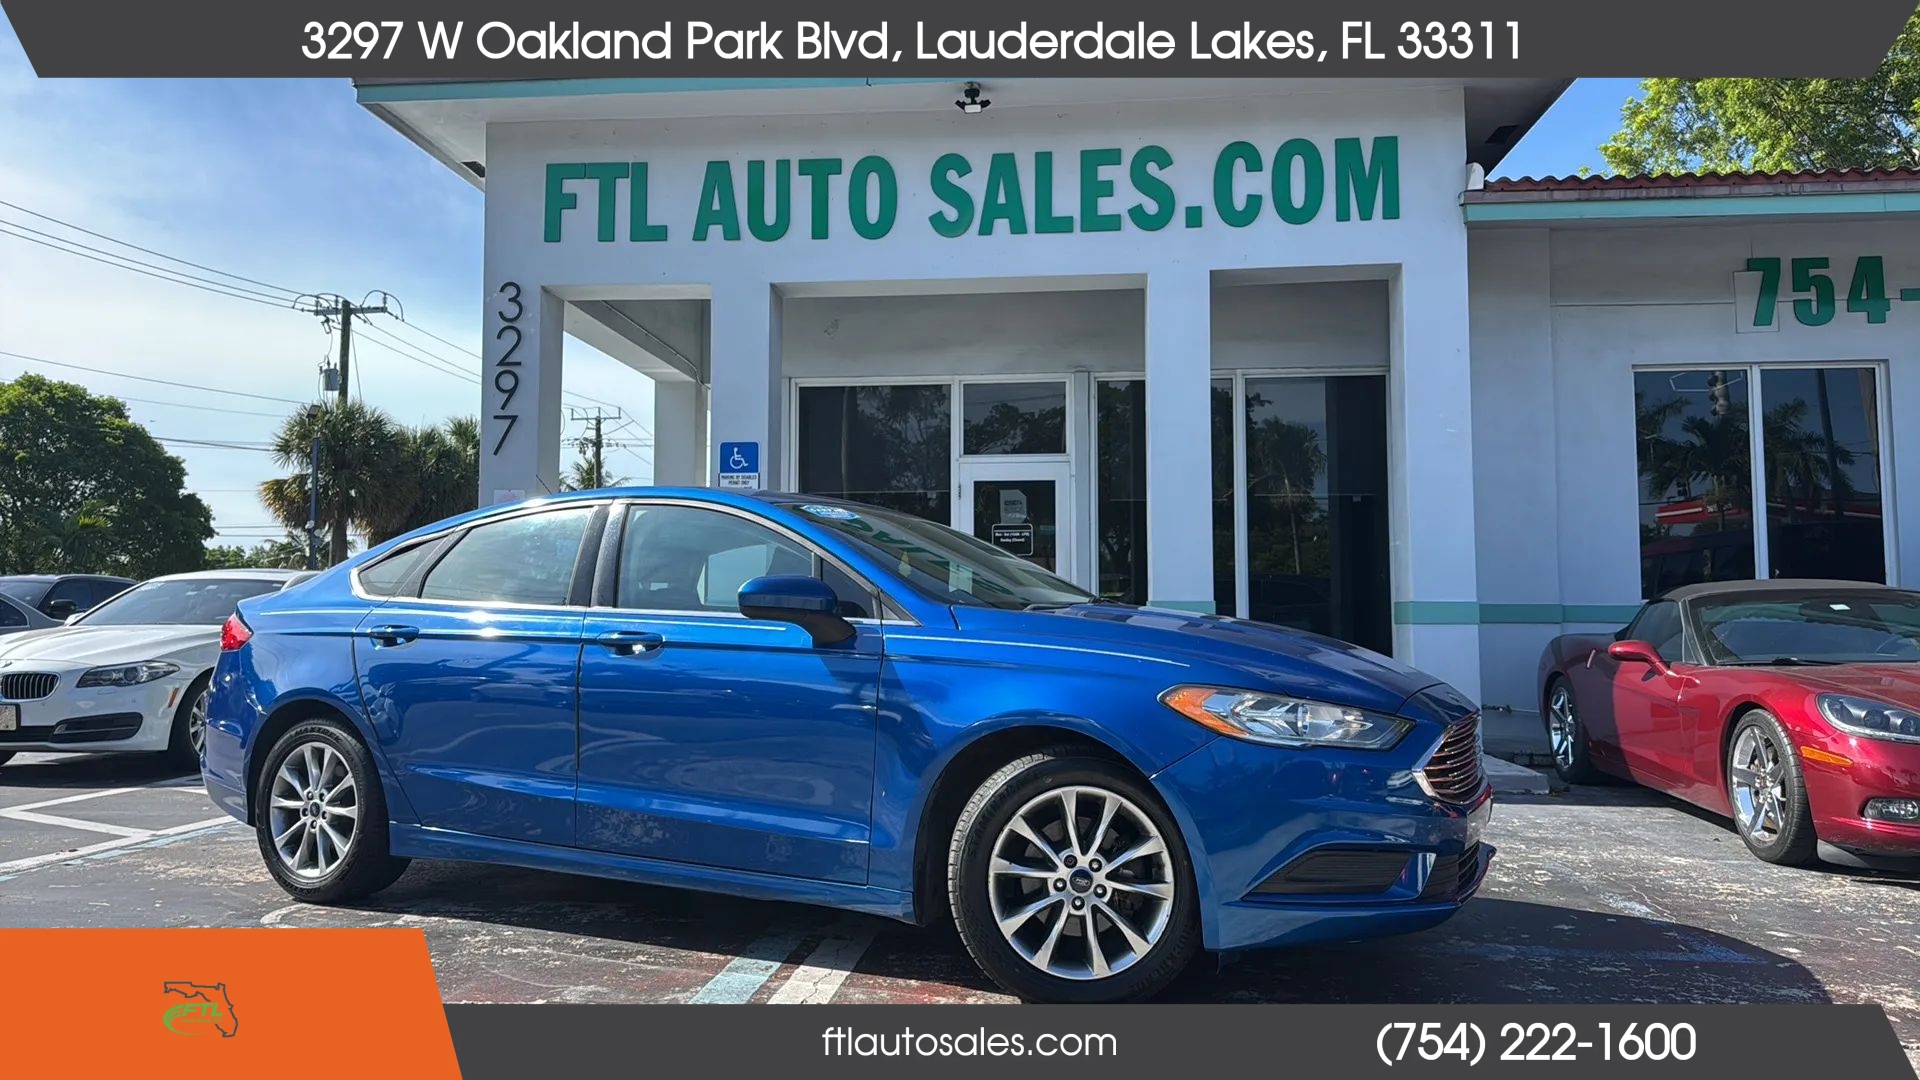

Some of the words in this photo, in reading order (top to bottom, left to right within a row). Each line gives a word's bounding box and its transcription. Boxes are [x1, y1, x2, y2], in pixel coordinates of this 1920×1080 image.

[544, 163, 668, 243] FTL
[693, 156, 898, 241] AUTO
[929, 136, 1401, 238] SALES.COM
[493, 281, 523, 456] 3297
